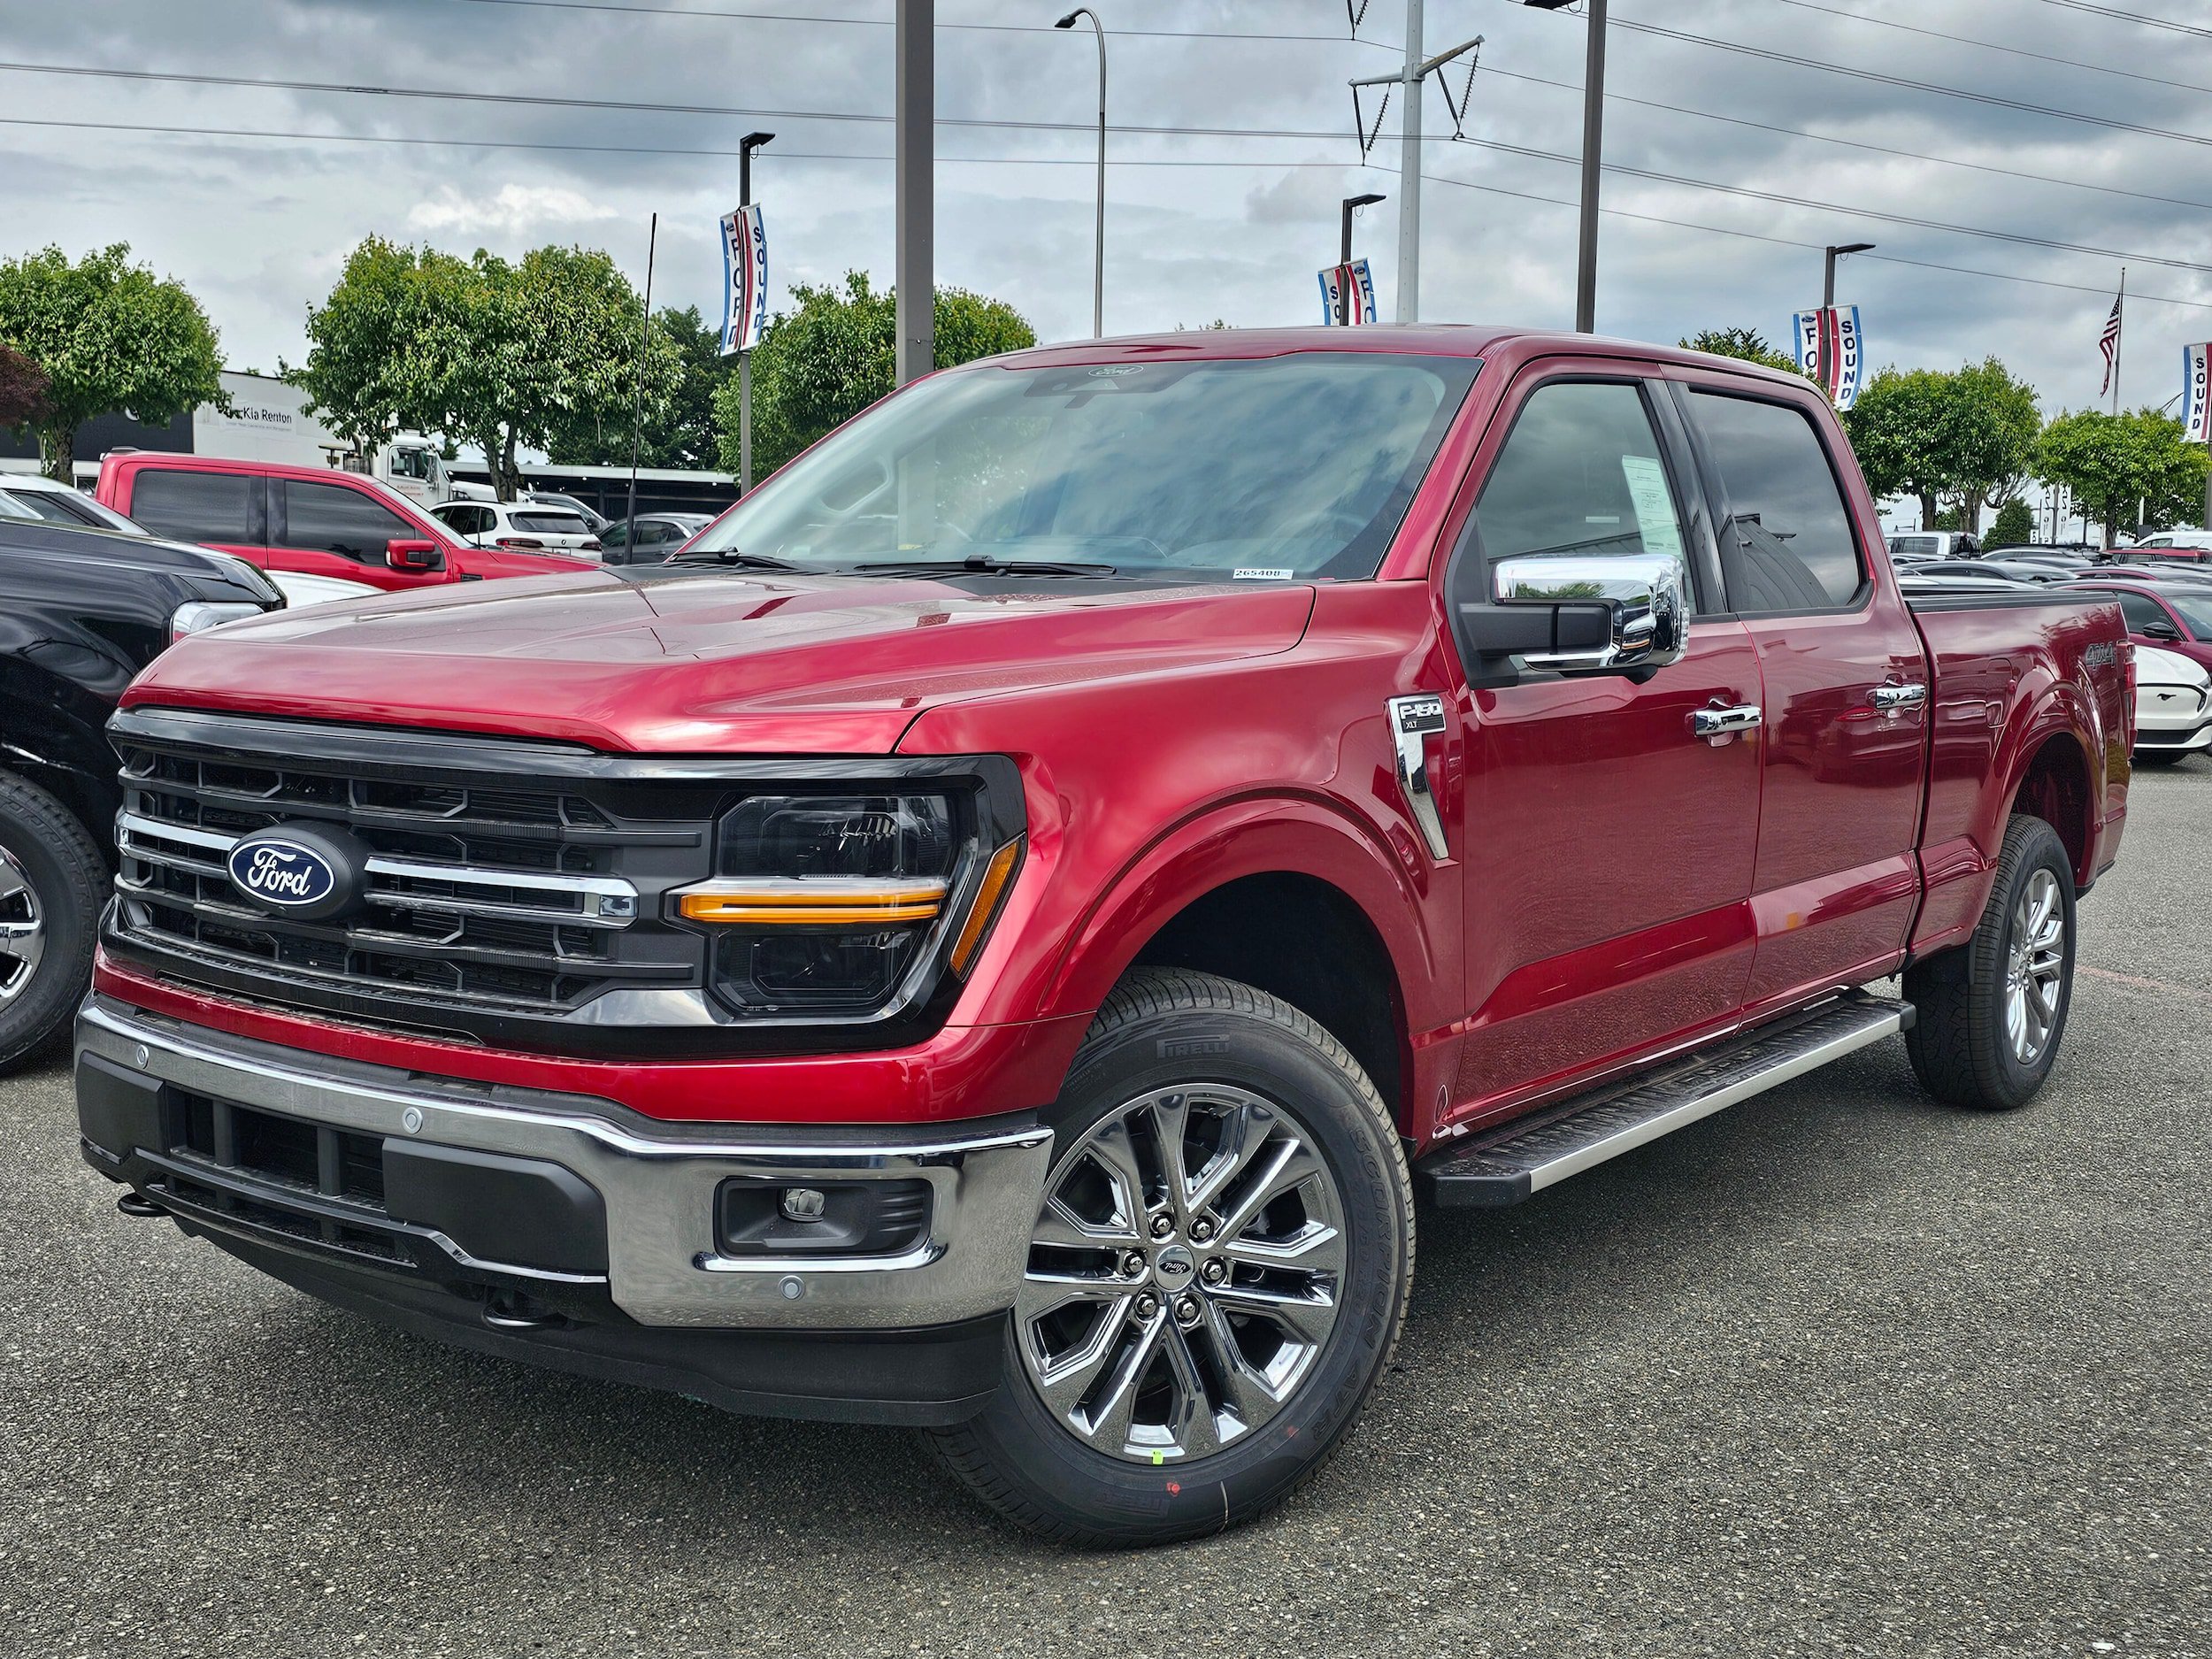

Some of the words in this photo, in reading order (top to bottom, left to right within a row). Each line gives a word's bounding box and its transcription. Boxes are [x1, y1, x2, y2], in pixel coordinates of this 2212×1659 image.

[753, 227, 765, 329] SOUND
[1840, 320, 1856, 400] SOUND
[243, 406, 259, 420] Kia
[262, 409, 292, 424] Renton
[2192, 357, 2206, 430] SOUND
[1399, 703, 1442, 720] F-150
[248, 848, 312, 896] Ford
[1156, 1034, 1230, 1059] PIRELLI
[1349, 1126, 1393, 1351] SCORPION
